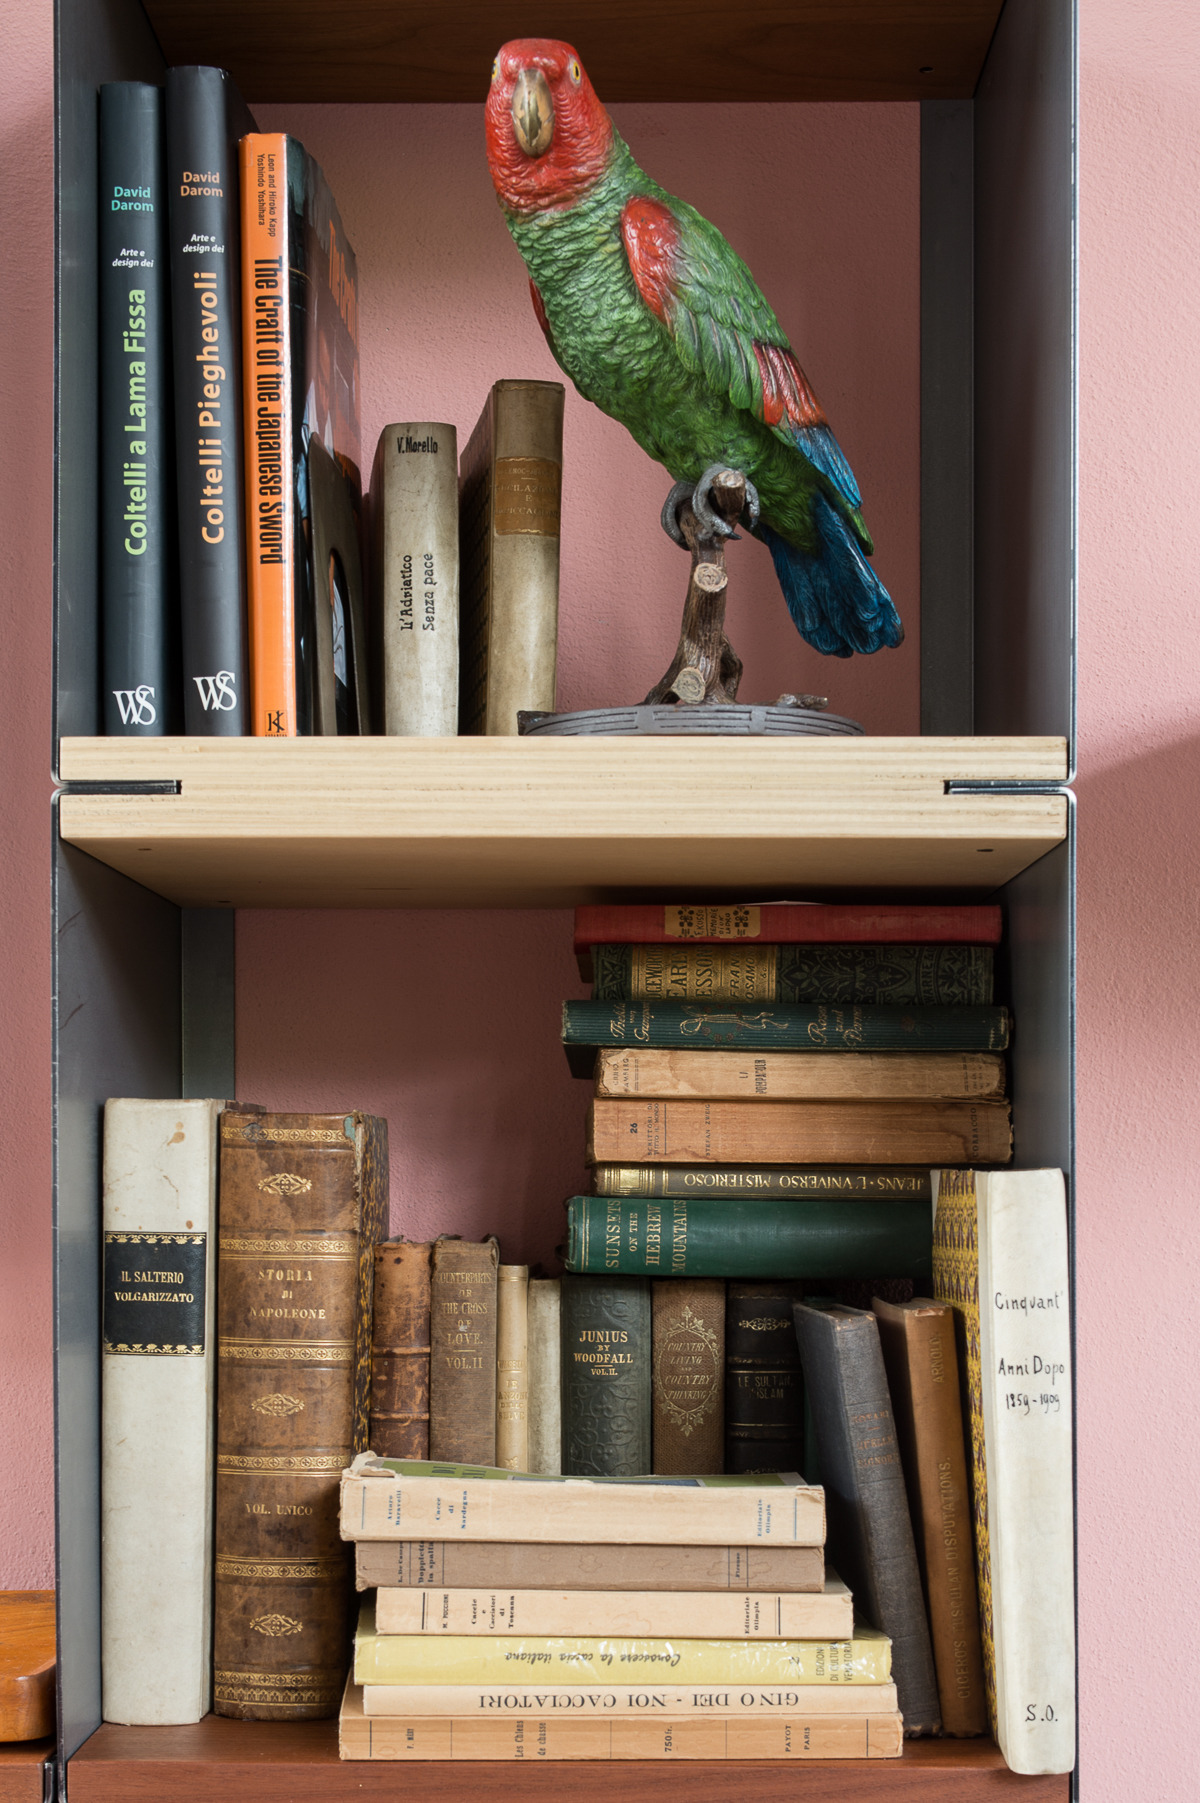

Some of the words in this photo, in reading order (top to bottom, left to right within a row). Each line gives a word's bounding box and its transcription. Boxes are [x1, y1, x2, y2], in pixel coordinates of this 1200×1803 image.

[257, 153, 265, 187] Yoshindo
[267, 154, 275, 172] Leon
[182, 171, 220, 183] David
[268, 174, 276, 189] and
[113, 186, 151, 198] David
[180, 185, 224, 197] Darom
[111, 199, 154, 212] Darom
[257, 189, 265, 226] Yoshihara
[268, 190, 276, 215] Hiroko
[268, 216, 276, 237] Kapp
[190, 233, 208, 242] Arte
[119, 248, 137, 257] Arte
[182, 243, 210, 254] design
[211, 244, 225, 253] dei
[112, 258, 140, 269] design
[140, 258, 154, 268] dei
[254, 255, 283, 289] The
[123, 288, 146, 353] Fissa
[255, 294, 285, 344] Craft
[194, 271, 226, 428] Pieghevoli
[256, 348, 286, 367] of
[257, 373, 286, 402] the
[124, 361, 147, 433] Lama
[130, 440, 146, 455] a
[256, 406, 284, 496] Japanese
[199, 438, 224, 544] Coltelli
[123, 462, 147, 556] Coltelli
[258, 502, 287, 564] Sword
[424, 552, 438, 586] pace
[400, 554, 413, 631] L'Adriatico
[422, 590, 435, 631] Senza
[667, 950, 687, 1000] EARLY
[629, 1122, 638, 1134] 26
[684, 1173, 771, 1187] MISTERIOSO
[629, 1212, 638, 1233] THE
[605, 1200, 621, 1268] SUNSETS
[646, 1204, 661, 1266] HEBREW
[671, 1199, 687, 1273] MOUNTAINS
[629, 1236, 637, 1252] ON
[121, 1270, 132, 1282] IL
[134, 1271, 184, 1284] SALTERIO
[258, 1269, 313, 1281] STORIA
[114, 1291, 195, 1303] VOLGARIZZATO
[281, 1290, 293, 1299] DI
[249, 1306, 327, 1319] NAPOLEONE
[441, 1302, 458, 1314] THE
[461, 1302, 488, 1315] CROSS
[579, 1330, 628, 1343] JUNIUS
[667, 1342, 707, 1351] COUNTRY
[573, 1352, 634, 1364] WOODFALL
[670, 1355, 703, 1365] LIVING
[998, 1357, 1030, 1376] Anni
[1033, 1354, 1066, 1386] Dopo
[664, 1374, 713, 1385] COUNTRY
[738, 1375, 750, 1388] LE
[667, 1390, 707, 1400] THINKING
[245, 1503, 271, 1515] VOL.
[276, 1504, 313, 1516] UNICO
[448, 1504, 454, 1514] di
[949, 1566, 965, 1632] TUSCULAN
[488, 1595, 496, 1630] Cacciatori
[499, 1608, 505, 1617] di
[503, 1652, 552, 1664] italiana
[558, 1653, 594, 1664] caccia
[600, 1654, 613, 1666] la
[619, 1653, 681, 1667] Conoscere
[829, 1641, 840, 1672] CULTURA
[843, 1640, 853, 1682] VENATORIA
[953, 1639, 970, 1699] CICERO'S
[829, 1673, 839, 1682] DI
[479, 1694, 617, 1708] CACCIATORI
[627, 1693, 666, 1707] NOI
[693, 1693, 730, 1706] DEI
[740, 1692, 799, 1707] GINO
[514, 1720, 524, 1743] Chiens
[537, 1722, 546, 1745] chasse
[514, 1745, 524, 1758] Les
[537, 1747, 546, 1756] de
